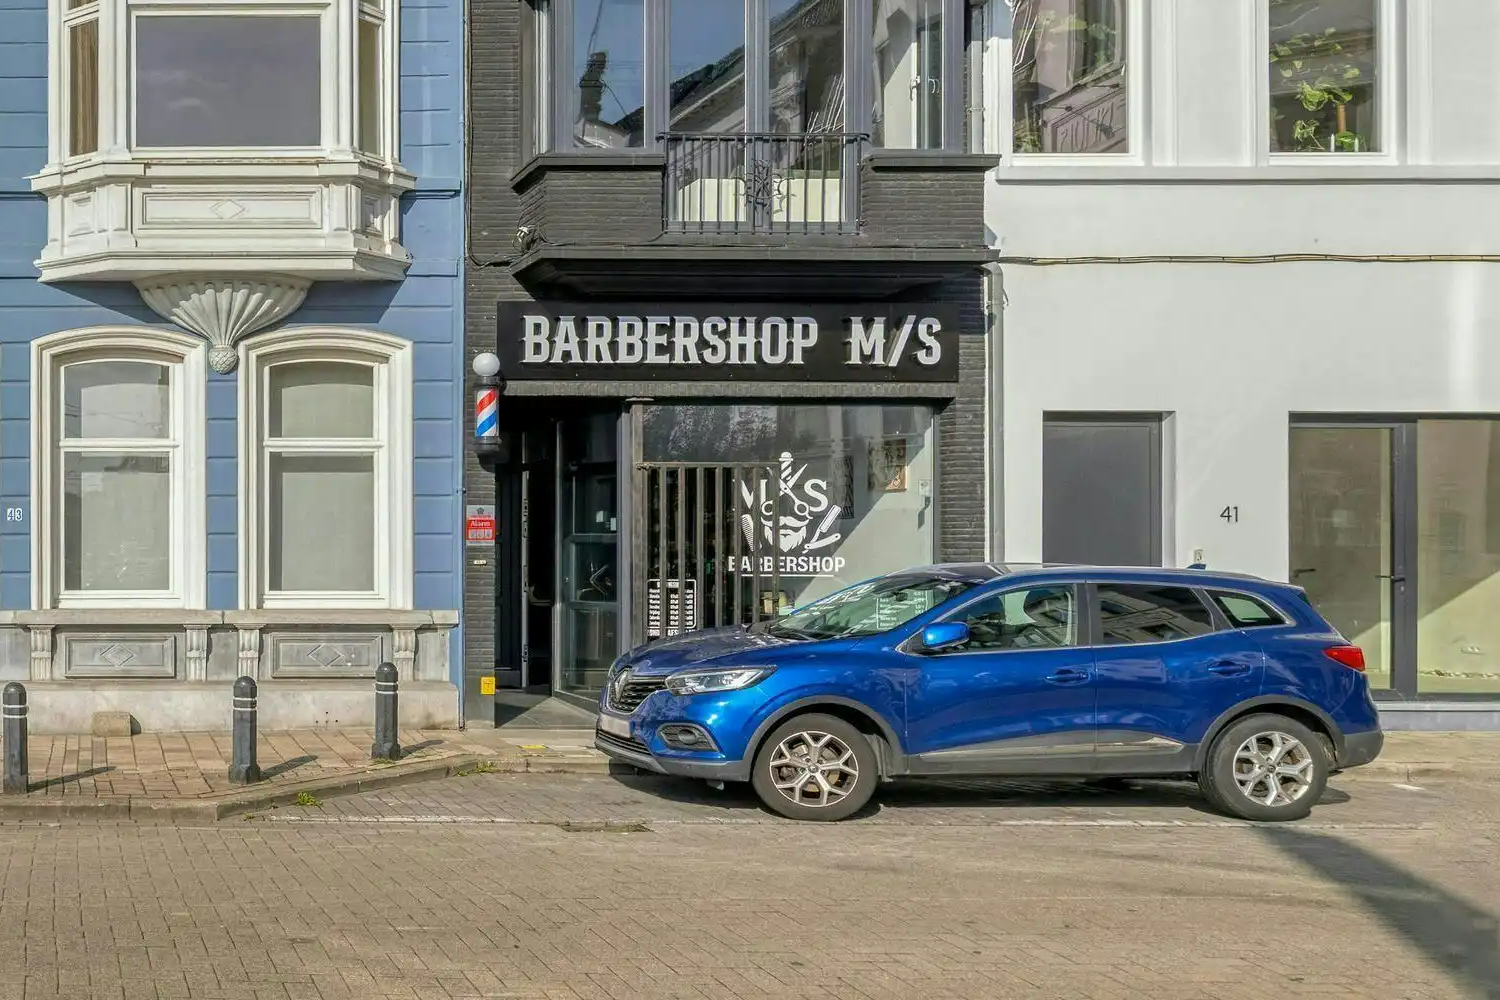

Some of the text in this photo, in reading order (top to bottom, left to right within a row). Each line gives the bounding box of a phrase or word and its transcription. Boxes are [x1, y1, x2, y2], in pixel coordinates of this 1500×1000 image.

[520, 314, 942, 367] BARBERSHOP M/S
[7, 507, 23, 521] 43
[1220, 505, 1238, 523] 41
